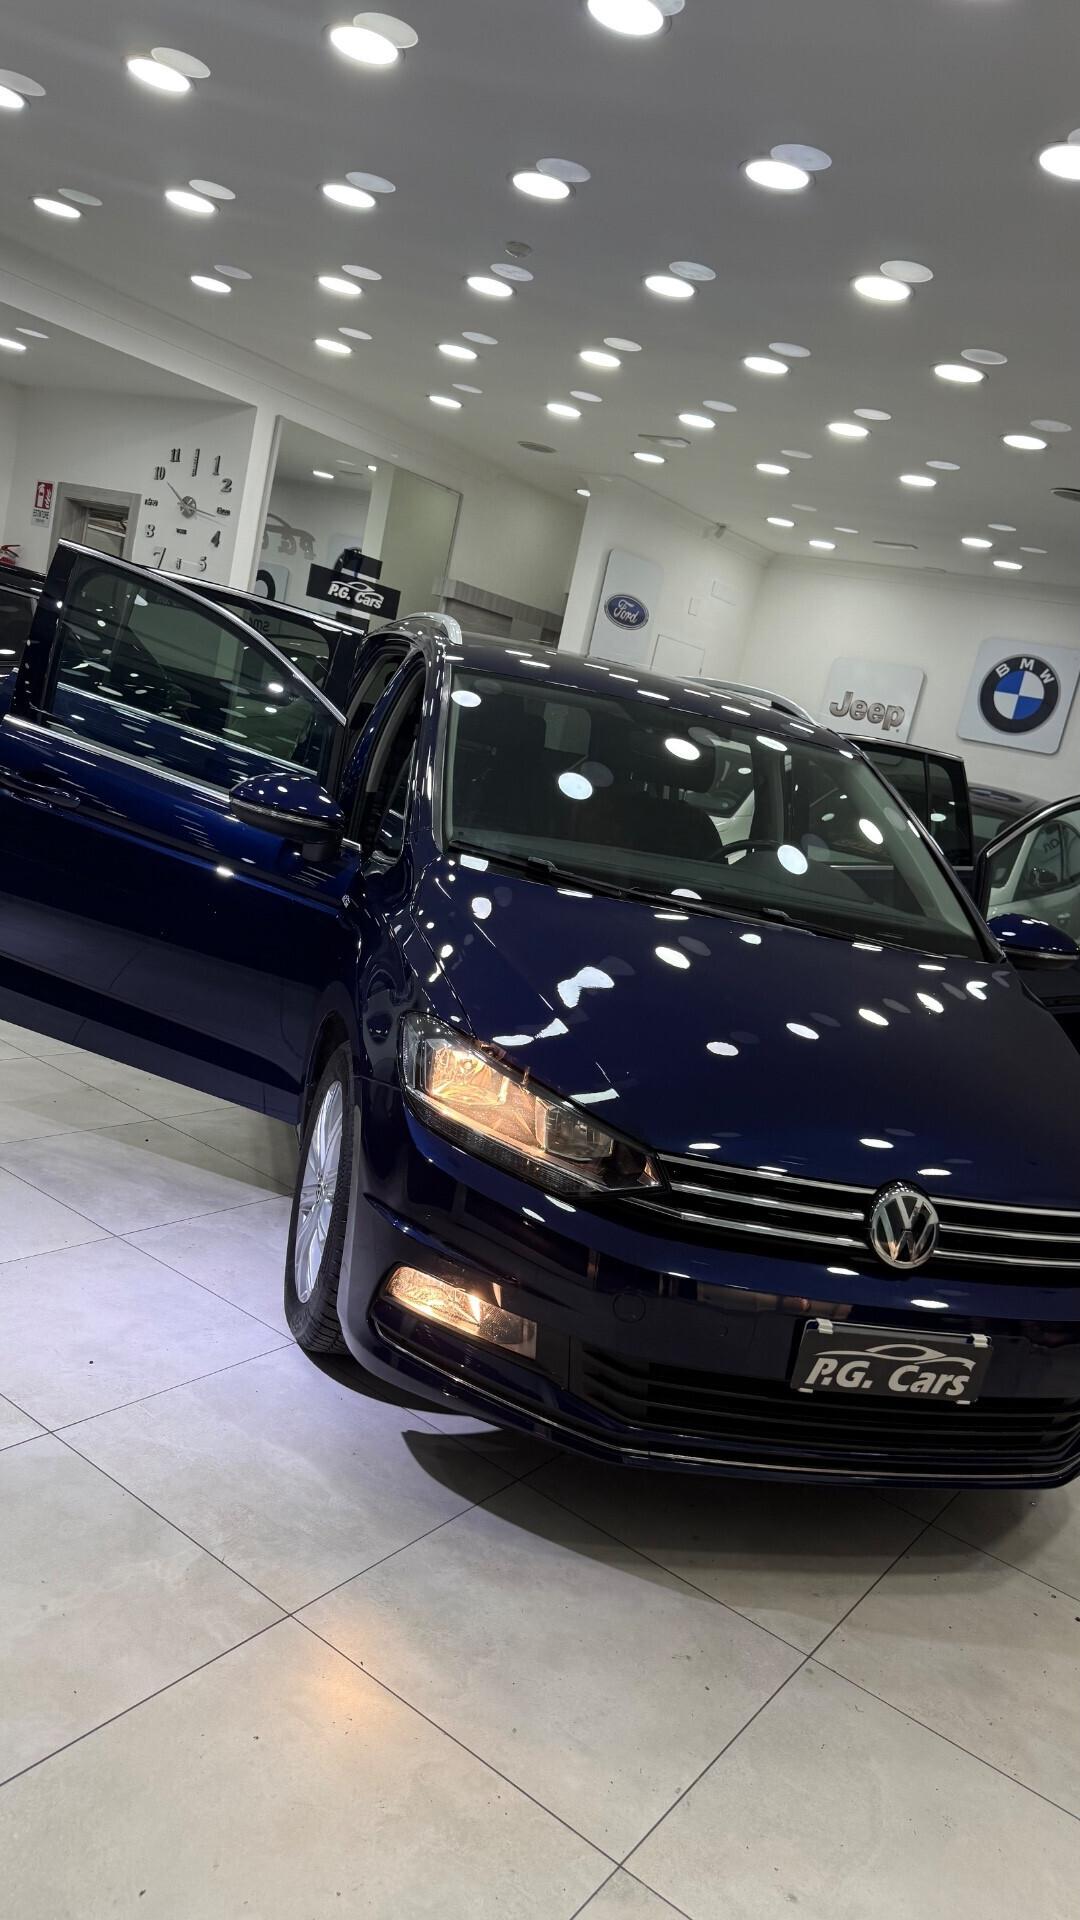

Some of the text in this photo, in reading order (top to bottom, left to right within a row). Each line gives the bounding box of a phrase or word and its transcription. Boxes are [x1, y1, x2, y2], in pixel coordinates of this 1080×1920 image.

[170, 448, 181, 463] 11
[212, 455, 221, 476] 1
[153, 466, 166, 481] 10
[220, 478, 233, 493] 2
[210, 530, 221, 548] 4
[153, 547, 167, 569] 7
[198, 556, 208, 572] 5
[327, 583, 383, 609] P.G. Cars
[613, 599, 640, 624] Ford
[995, 657, 1055, 684] BMW
[830, 690, 906, 731] Jeep
[804, 1357, 970, 1397] P.G. Cars
